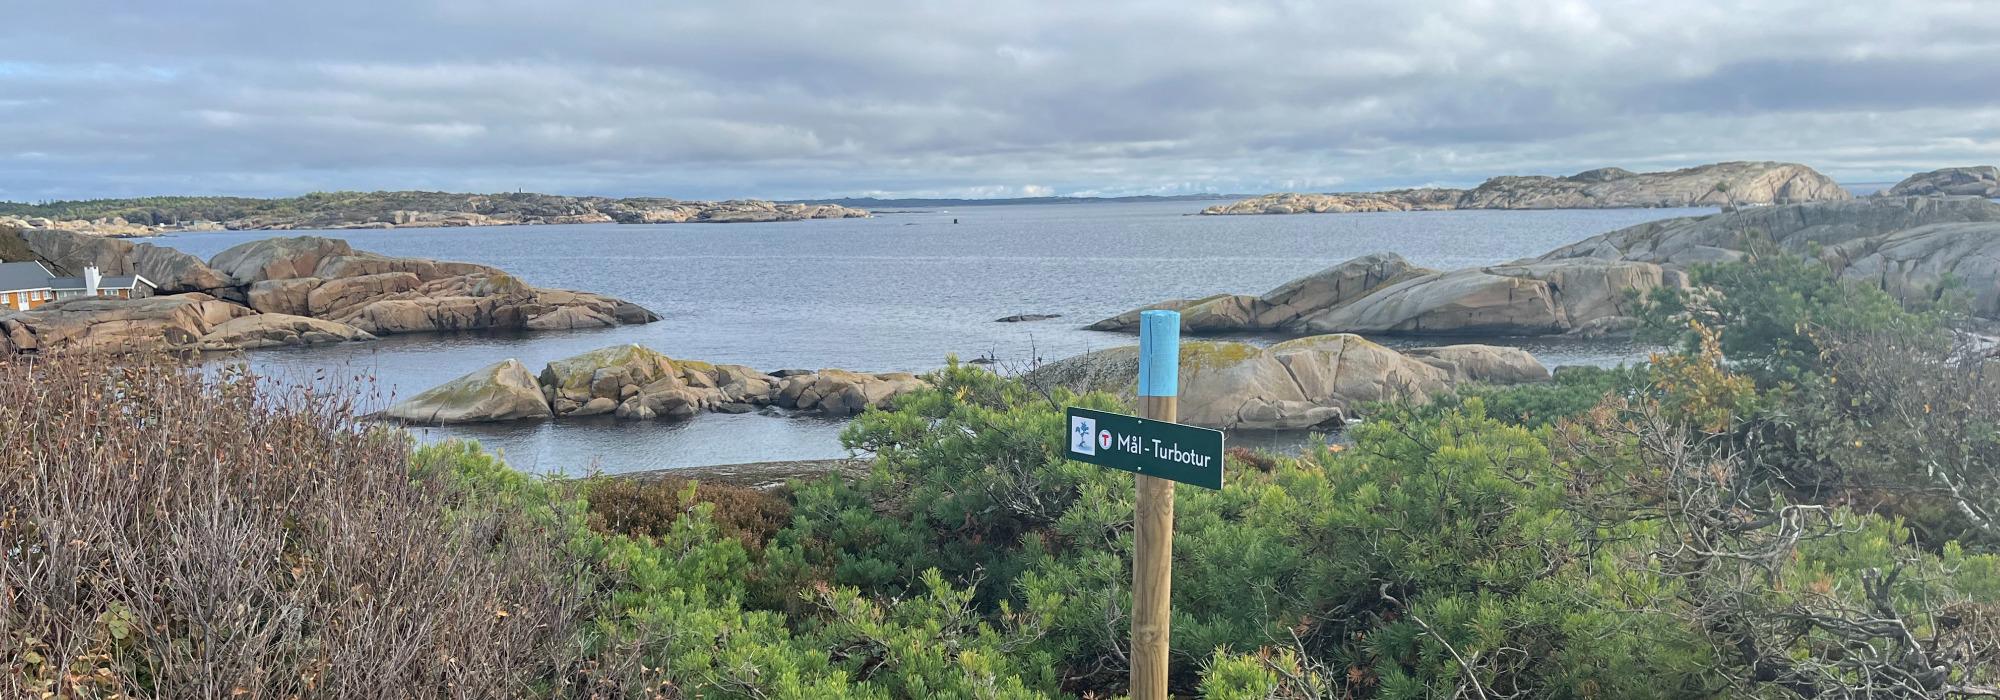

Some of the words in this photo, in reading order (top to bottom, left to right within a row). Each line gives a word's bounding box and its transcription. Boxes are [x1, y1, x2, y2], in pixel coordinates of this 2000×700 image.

[1101, 434, 1109, 446] T
[1117, 432, 1142, 454] Mål
[1151, 439, 1211, 467] Turbotur
